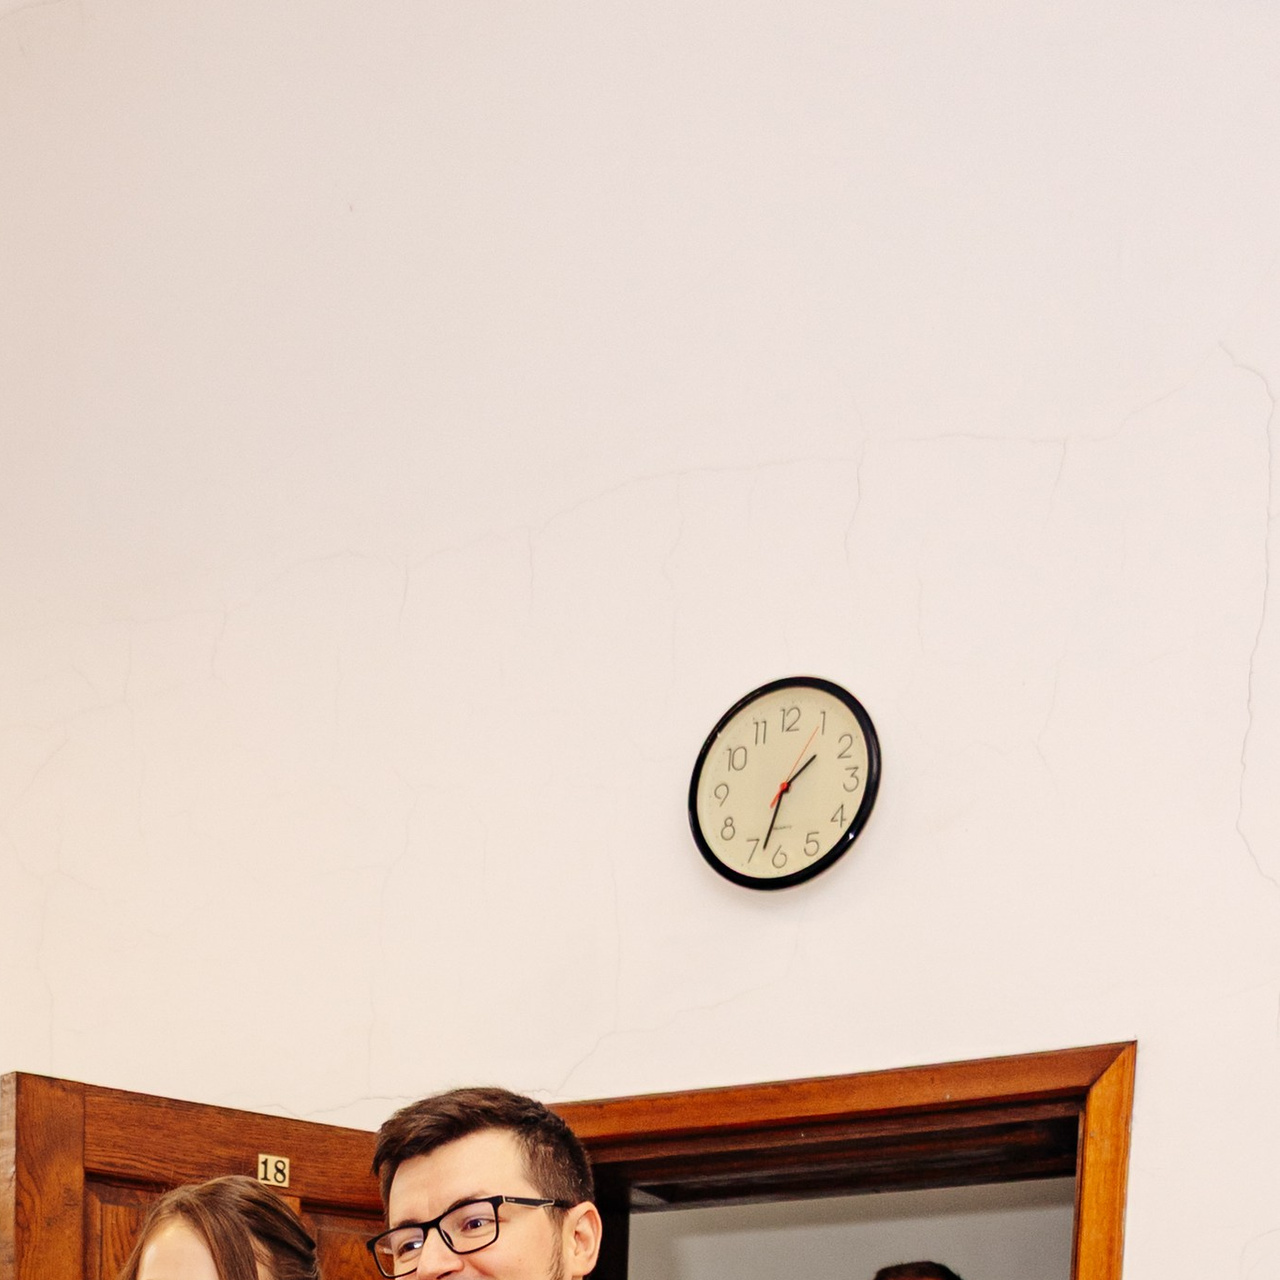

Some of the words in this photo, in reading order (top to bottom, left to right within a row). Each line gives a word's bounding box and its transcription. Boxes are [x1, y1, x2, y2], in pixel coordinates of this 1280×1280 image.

[781, 706, 801, 733] 12
[820, 711, 826, 735] 1
[753, 720, 767, 746] 11
[727, 746, 748, 772] 10
[837, 734, 853, 759] 2
[843, 766, 859, 792] 3
[714, 783, 729, 807] 9
[720, 816, 736, 841] 8
[830, 804, 847, 828] 4
[746, 838, 760, 863] 7
[804, 832, 820, 856] 5
[772, 845, 788, 869] 6
[261, 1158, 286, 1183] 18
